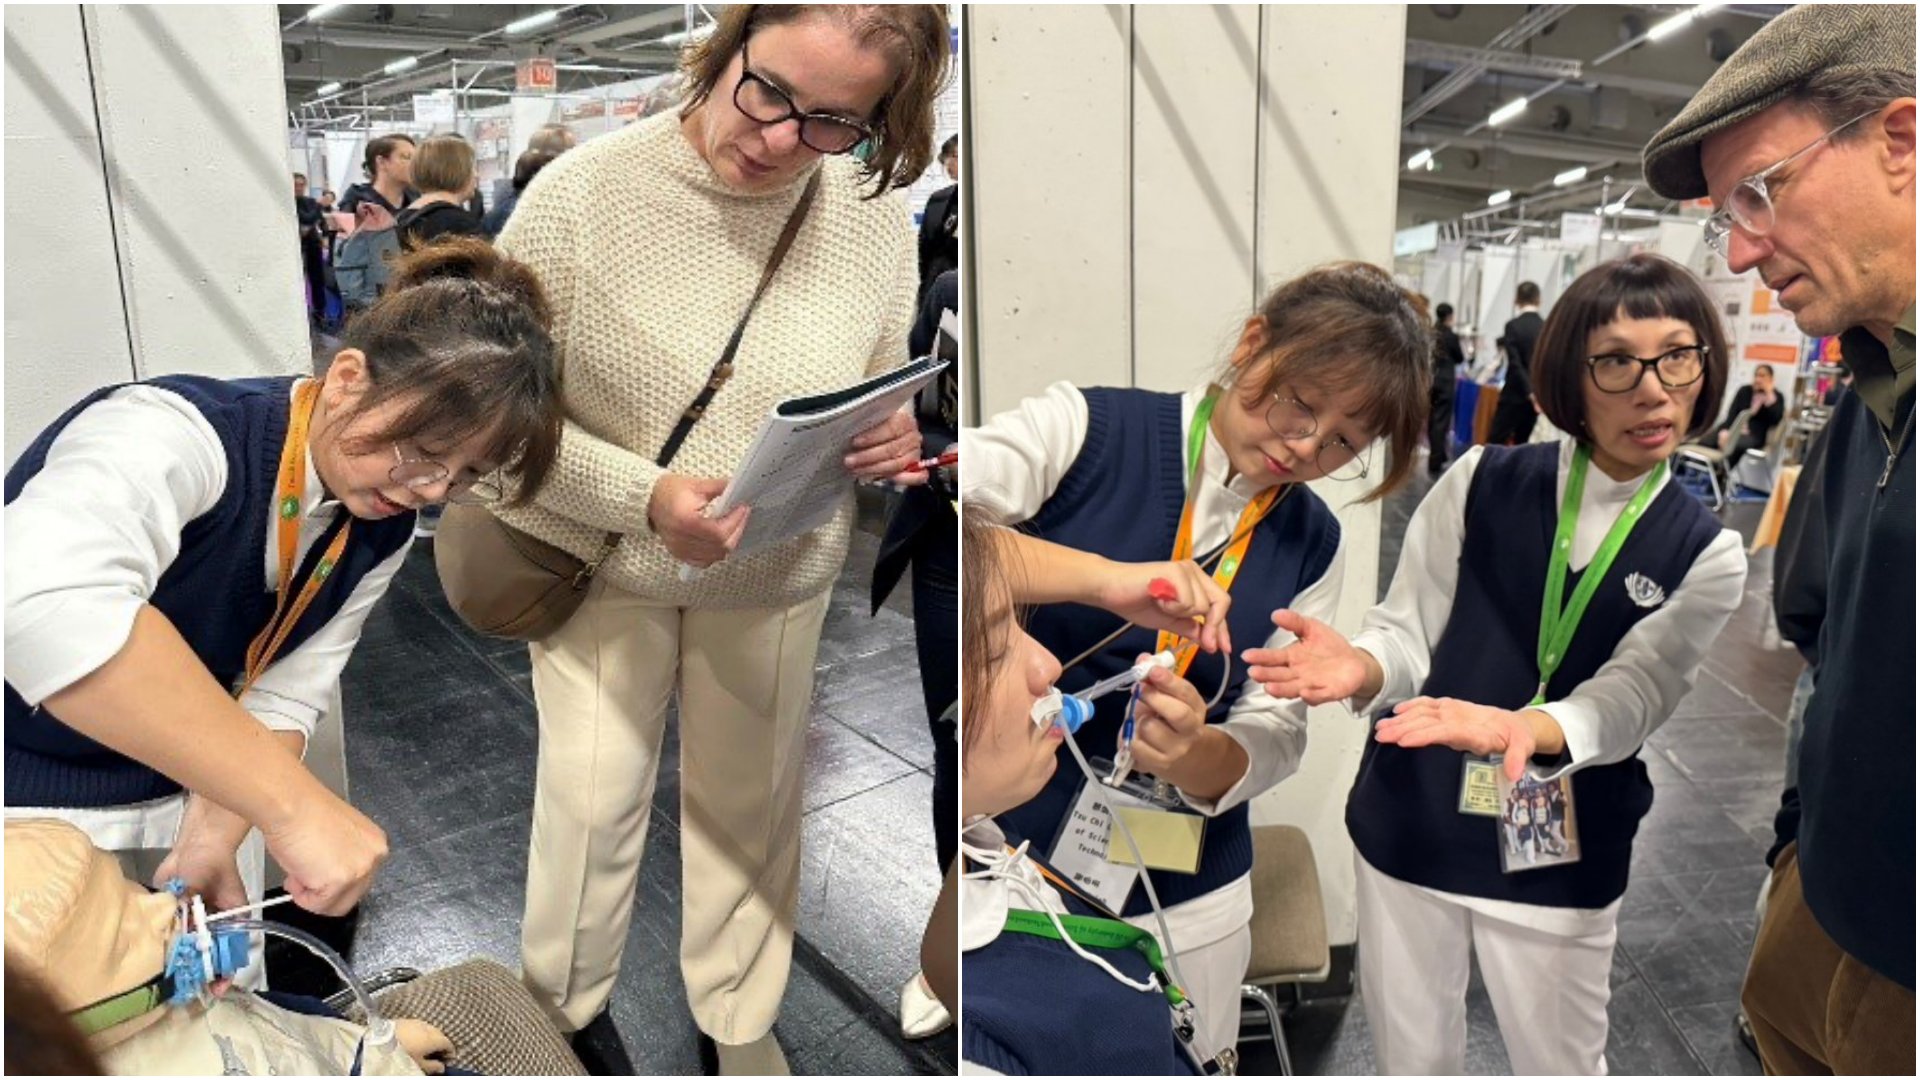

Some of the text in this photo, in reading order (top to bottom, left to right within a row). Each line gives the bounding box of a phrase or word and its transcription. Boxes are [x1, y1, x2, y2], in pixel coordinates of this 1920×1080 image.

[1073, 810, 1087, 821] Tzu
[1090, 816, 1104, 828] Chi
[1075, 828, 1085, 836] of
